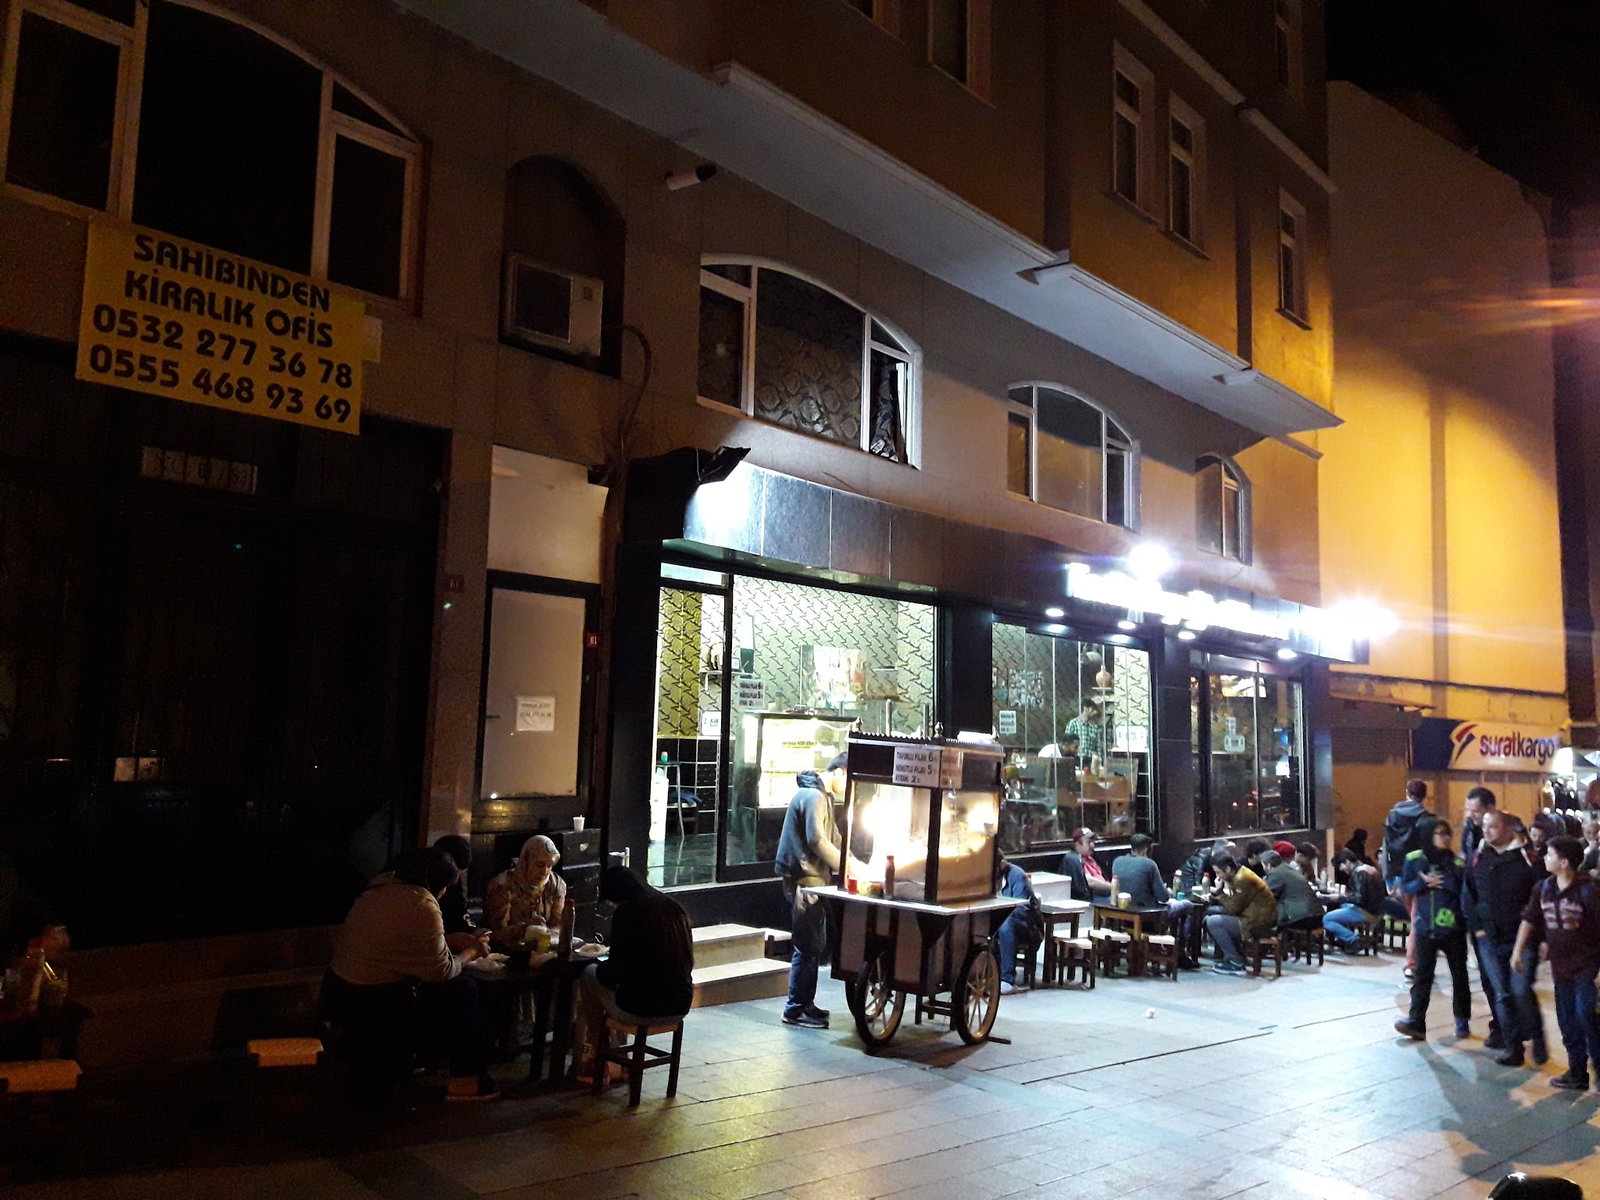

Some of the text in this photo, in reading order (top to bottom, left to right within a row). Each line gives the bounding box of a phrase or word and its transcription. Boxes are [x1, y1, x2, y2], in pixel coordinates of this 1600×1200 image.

[124, 268, 333, 348] KİRALIK OFİS
[134, 233, 330, 312] SAHİBİNDEN
[89, 344, 351, 424] 0555 468 93 69
[93, 304, 352, 389] 0532 277 36 78
